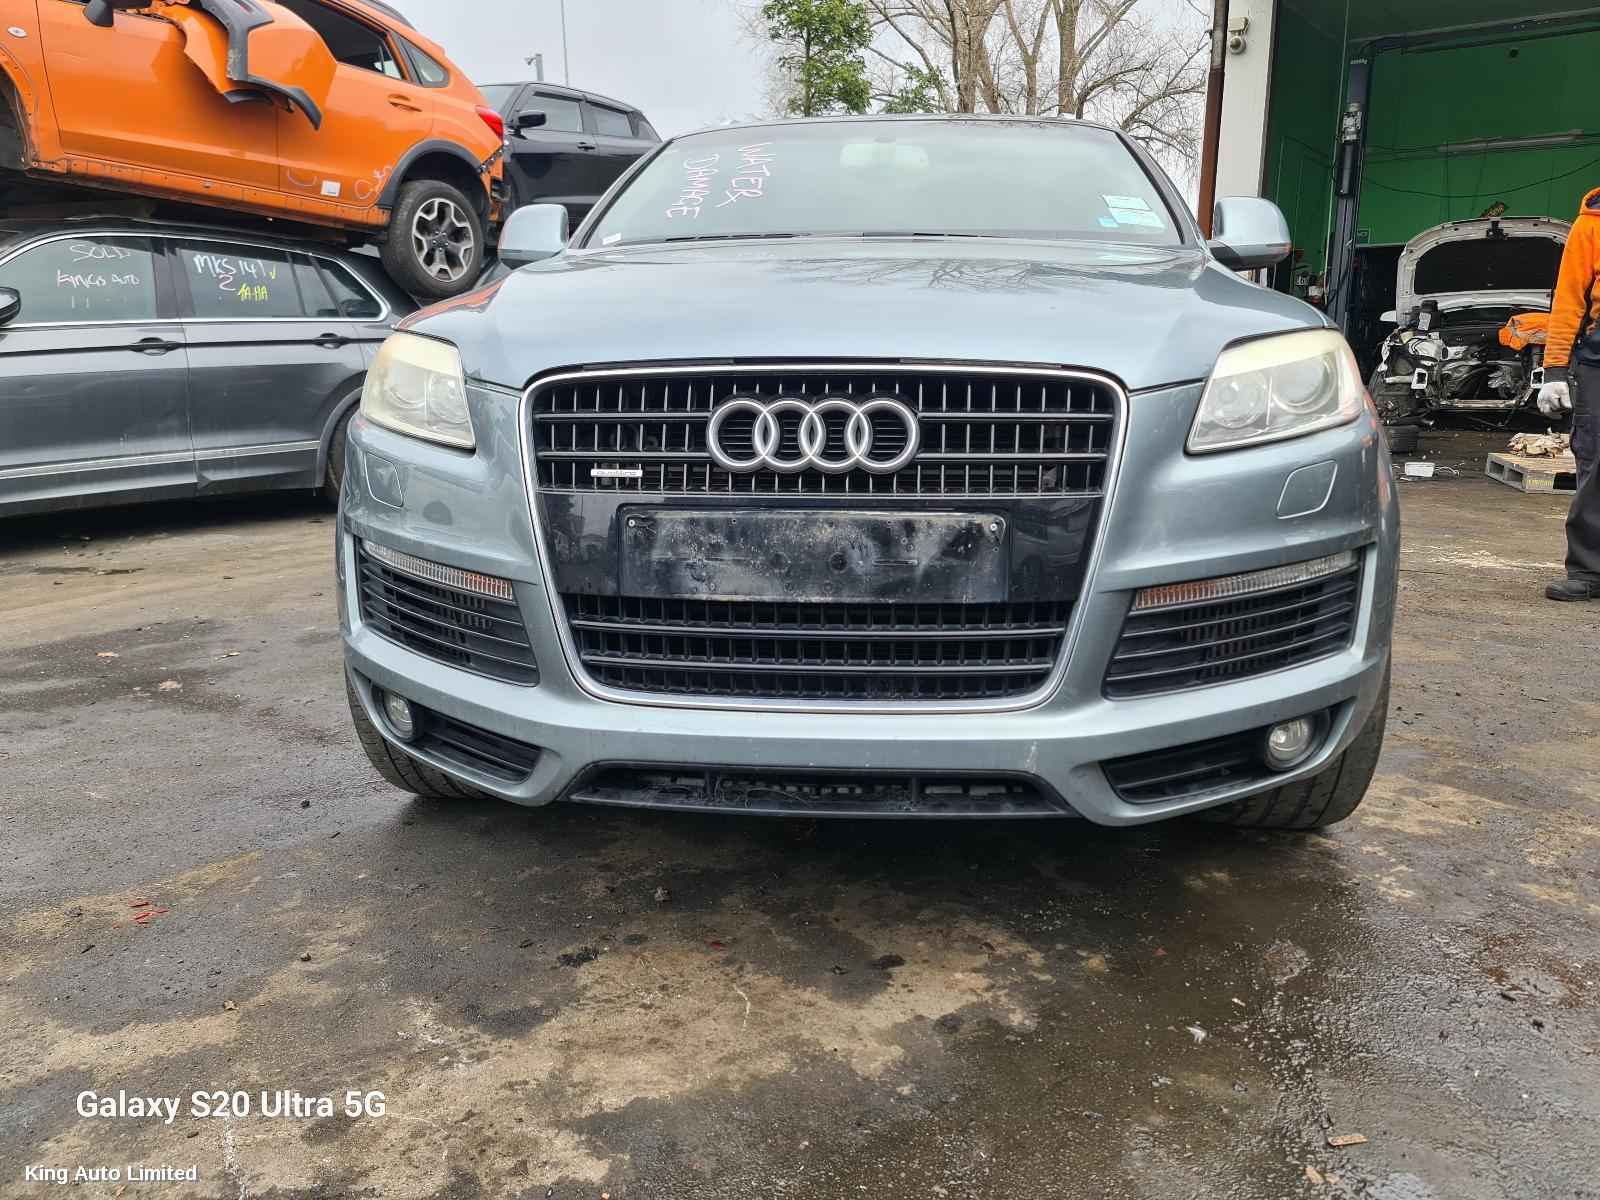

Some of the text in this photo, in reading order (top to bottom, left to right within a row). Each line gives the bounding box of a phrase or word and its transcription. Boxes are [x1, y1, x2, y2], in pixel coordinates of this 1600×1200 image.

[666, 153, 720, 219] DAMAGE
[69, 244, 132, 262] SOLD
[218, 274, 237, 291] 2
